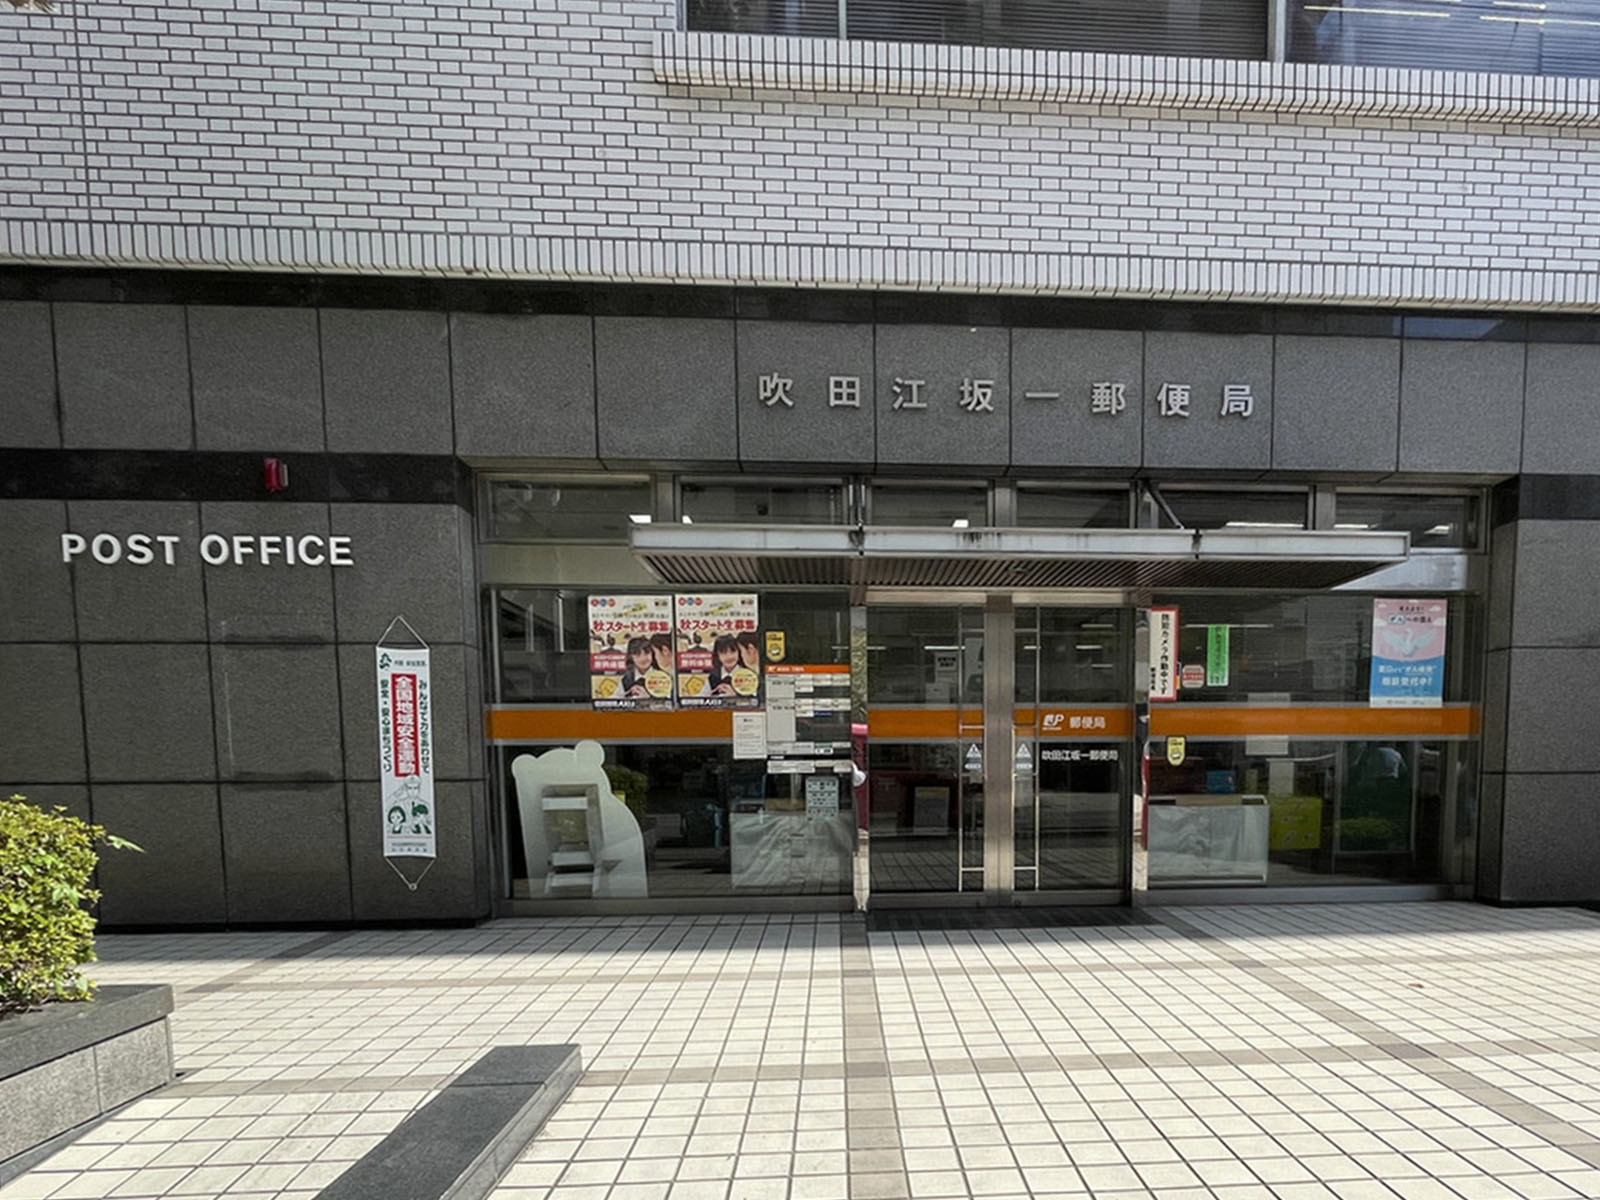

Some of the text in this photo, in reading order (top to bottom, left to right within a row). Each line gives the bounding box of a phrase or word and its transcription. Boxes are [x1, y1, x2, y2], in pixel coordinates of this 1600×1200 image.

[757, 372, 1254, 418] 吹田江坂一郵便局
[61, 533, 354, 566] POST OFFICE
[593, 620, 669, 632] 秋スタート生募集
[680, 619, 755, 631] 秋スタート生募集
[1069, 716, 1106, 729] 郵便局
